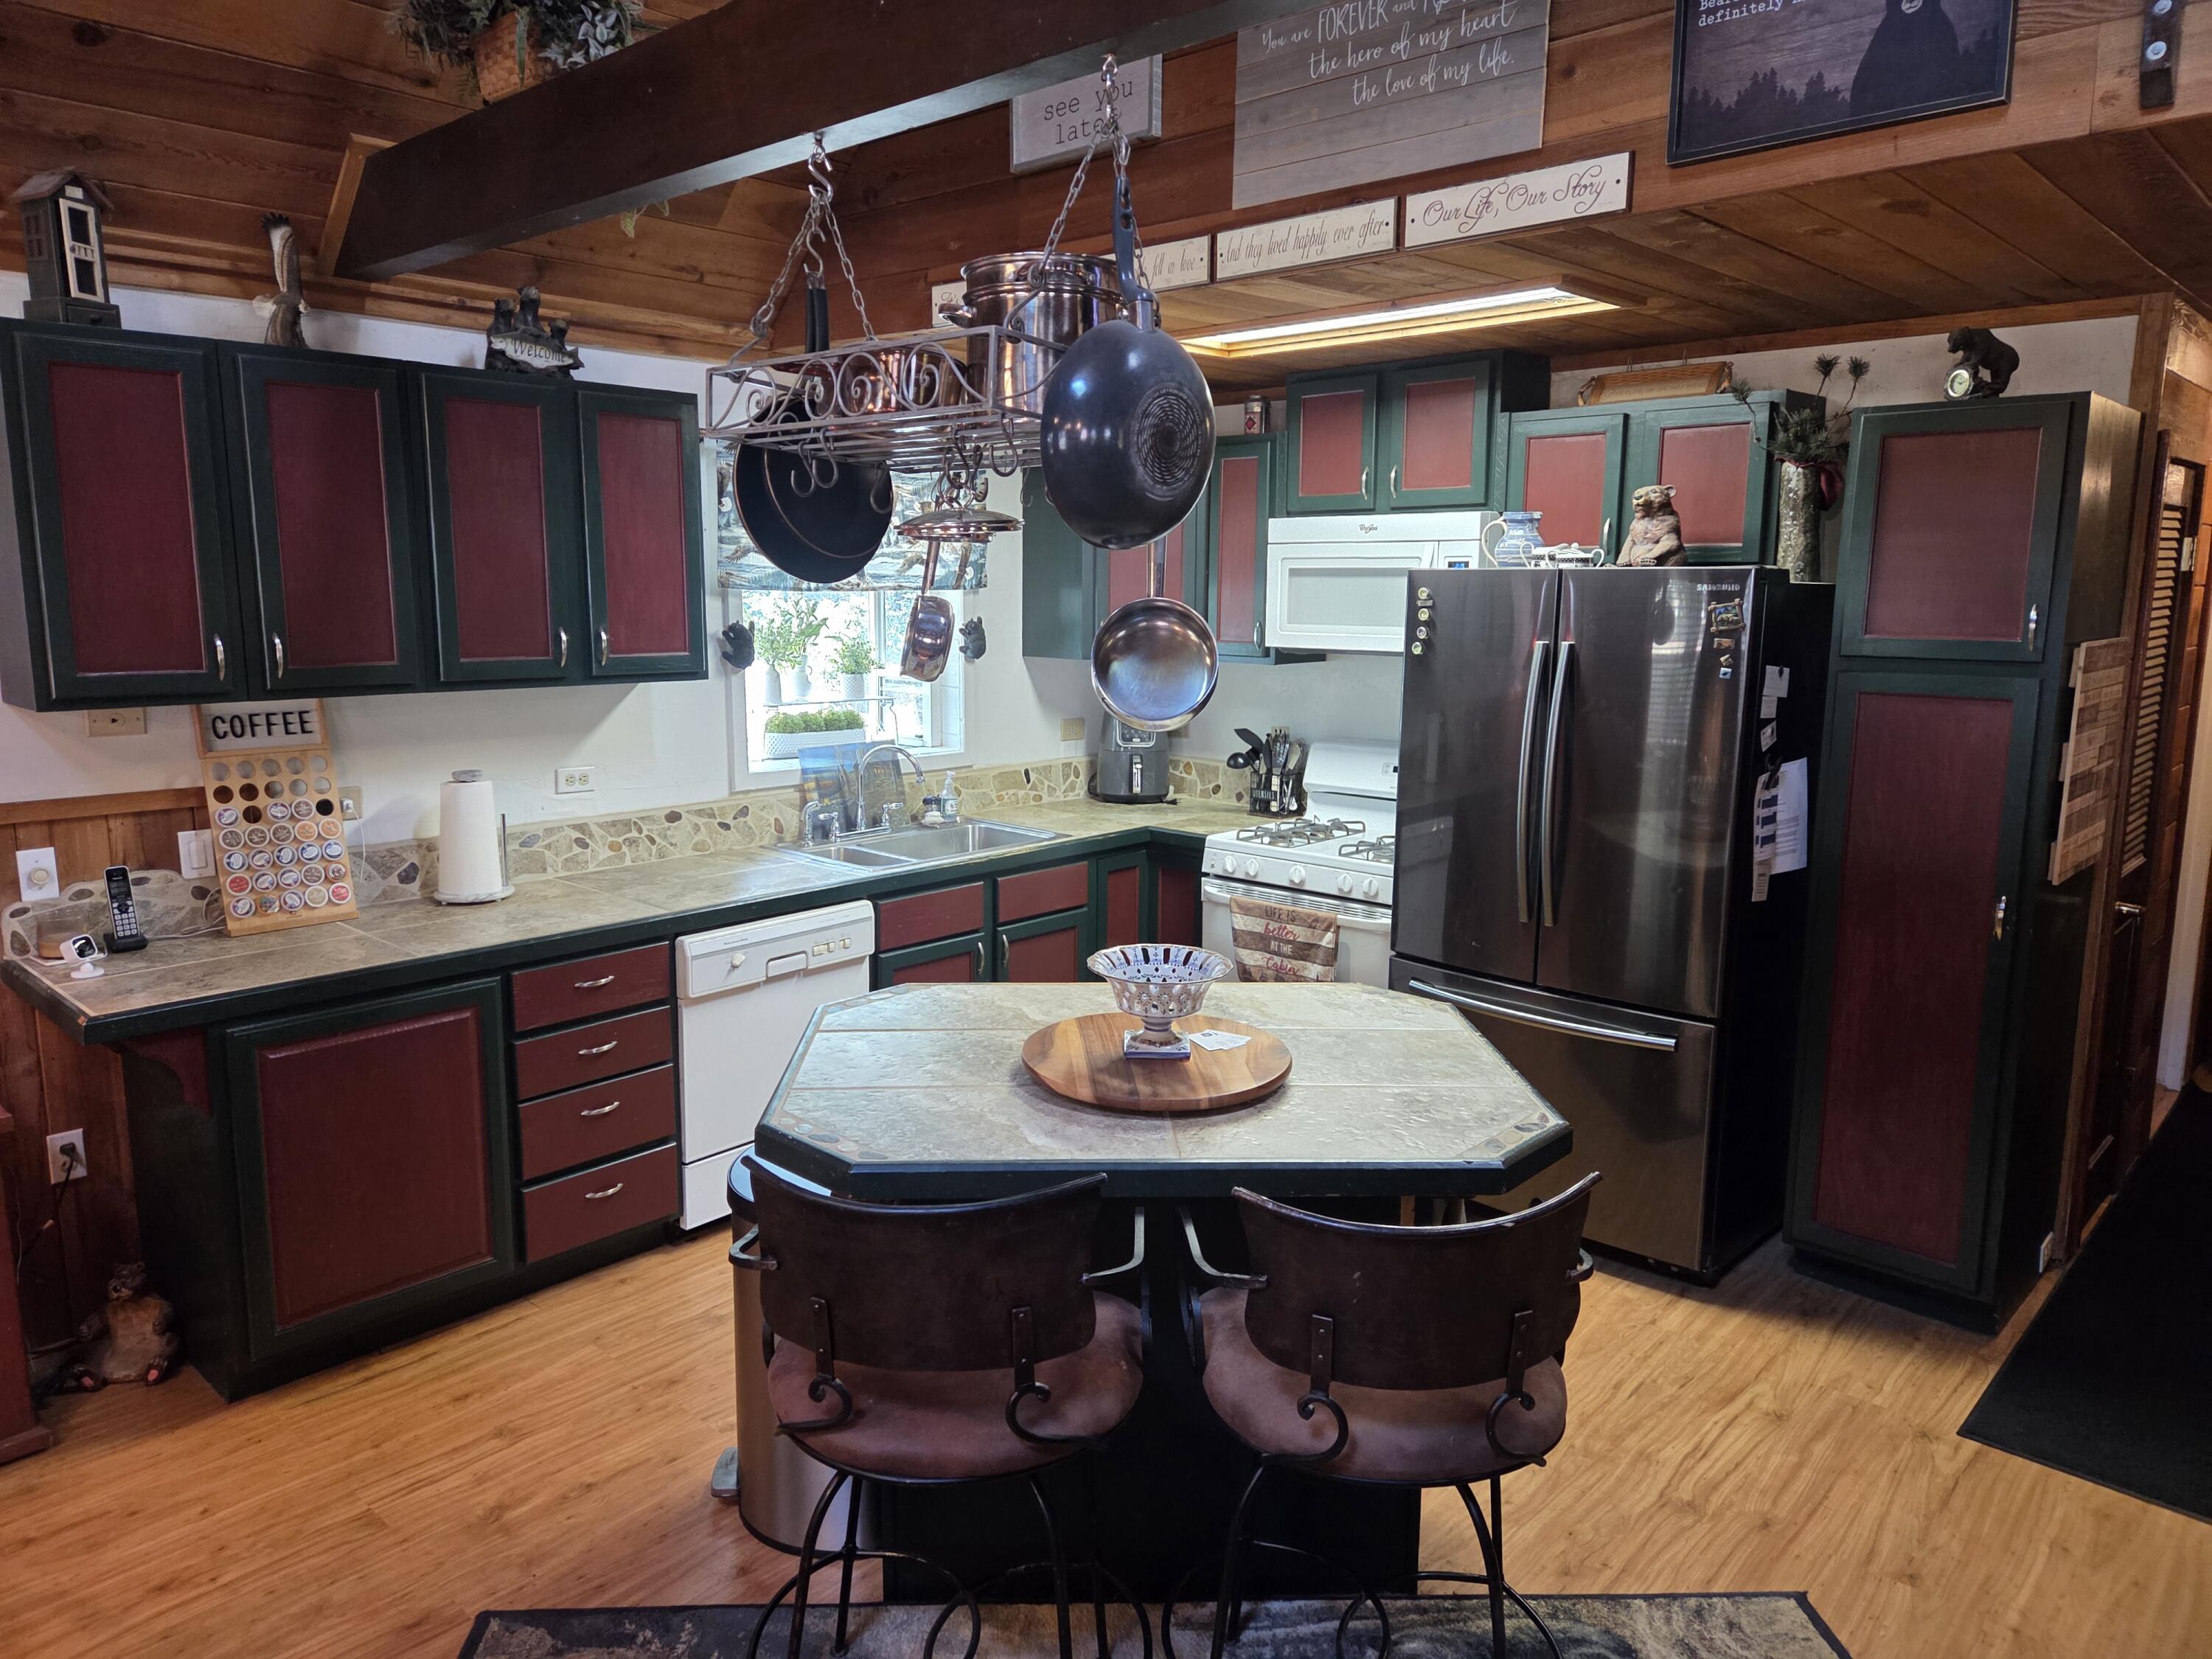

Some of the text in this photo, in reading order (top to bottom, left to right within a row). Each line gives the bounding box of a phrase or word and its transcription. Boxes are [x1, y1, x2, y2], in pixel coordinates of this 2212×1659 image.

[1262, 28, 1287, 54] You
[1291, 29, 1311, 43] are
[1318, 0, 1389, 44] FOREVER
[1391, 0, 1417, 13] and
[1698, 0, 1783, 27] definitely
[1309, 49, 1343, 79] the
[1347, 41, 1384, 68] hero
[1391, 21, 1416, 60] of
[1419, 29, 1455, 51] my
[1461, 0, 1522, 37] heart
[1352, 37, 1514, 105] the love of my life.
[1044, 81, 1133, 120] see you
[1056, 118, 1107, 145] late
[1423, 164, 1607, 233] Our Life, Our Story
[1245, 233, 1262, 268] they
[1267, 226, 1291, 256] lived
[1293, 219, 1328, 260] happily
[1332, 226, 1354, 244] ever
[1150, 252, 1165, 285] fell
[511, 338, 566, 363] Welcome
[212, 710, 313, 740] COFFEE
[1265, 905, 1296, 923] LIFE IS
[1263, 921, 1300, 941] better
[1270, 940, 1293, 955] AT THE
[1262, 956, 1300, 974] Cabin
